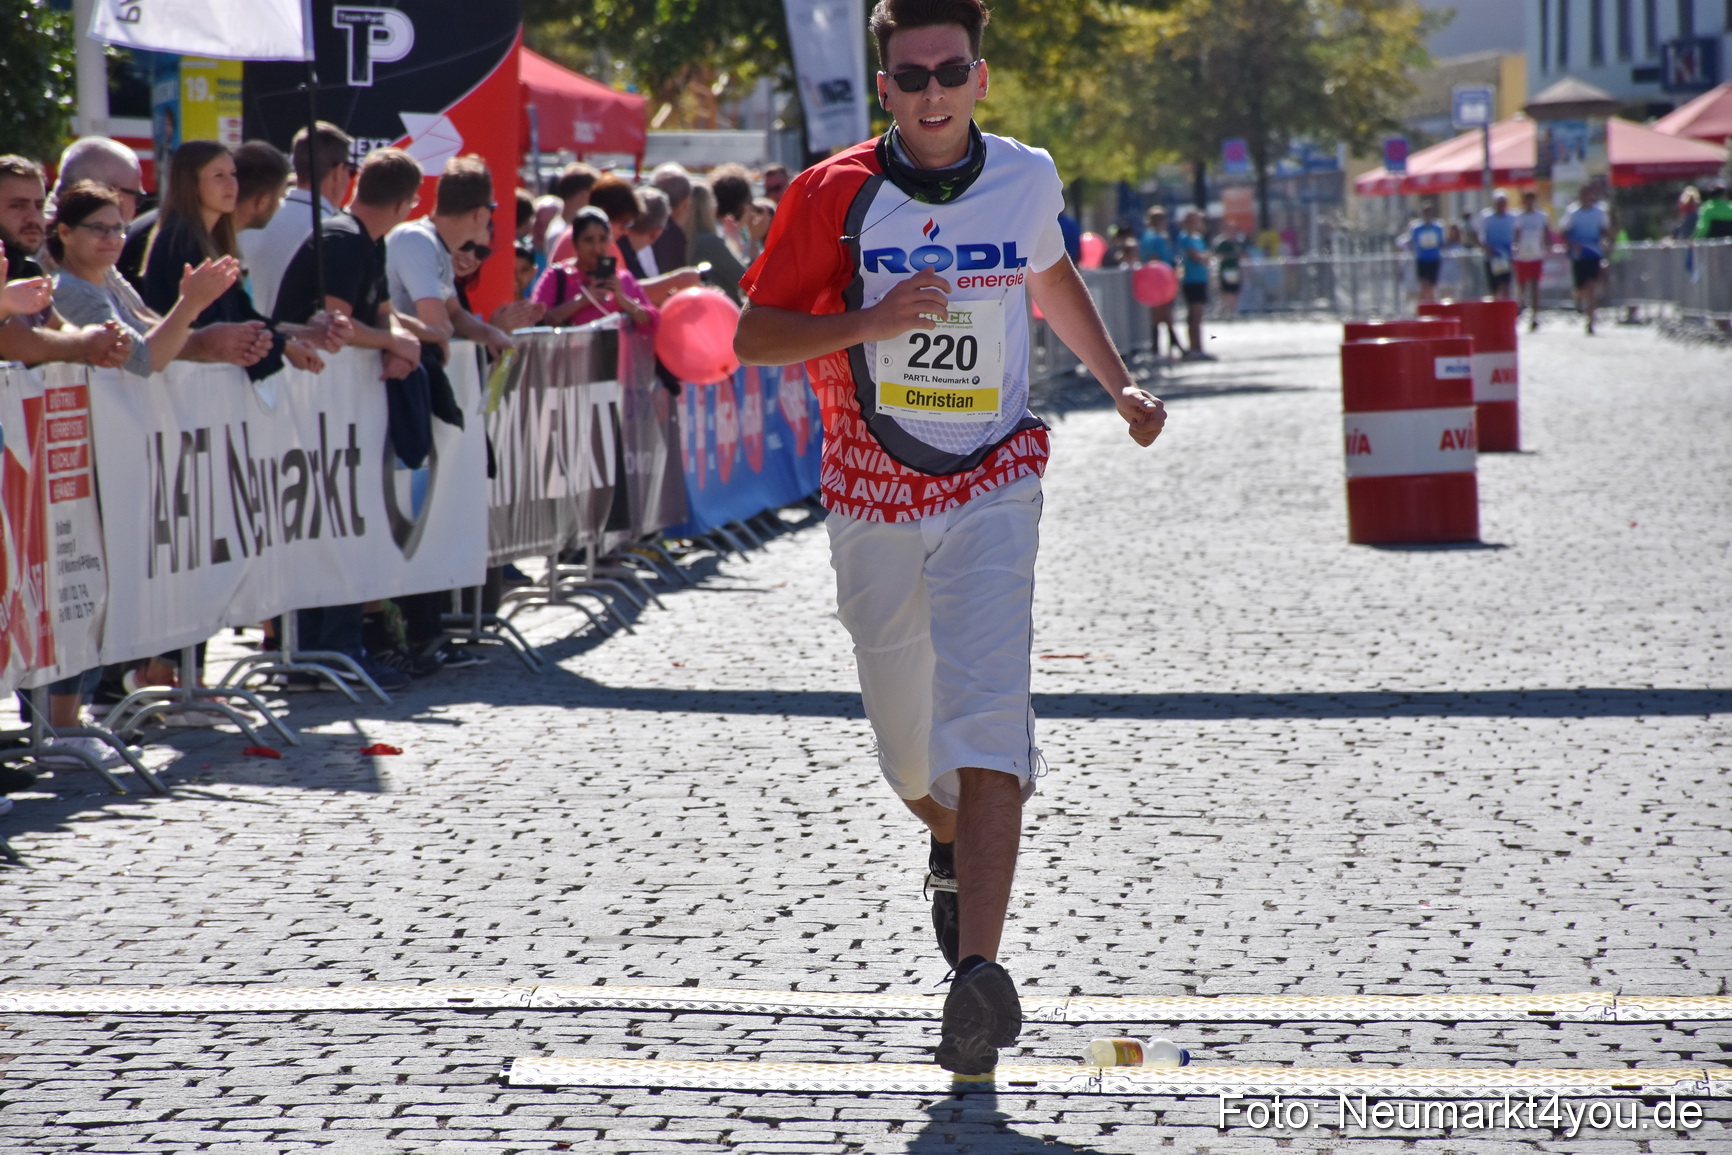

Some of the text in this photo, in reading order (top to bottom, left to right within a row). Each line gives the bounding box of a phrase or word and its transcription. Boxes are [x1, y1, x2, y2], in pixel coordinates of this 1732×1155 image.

[956, 266, 1024, 289] energie
[907, 332, 978, 371] 220
[903, 373, 970, 385] PARTL Neumarkt
[906, 389, 974, 409] Christian
[850, 478, 914, 506] AVIA
